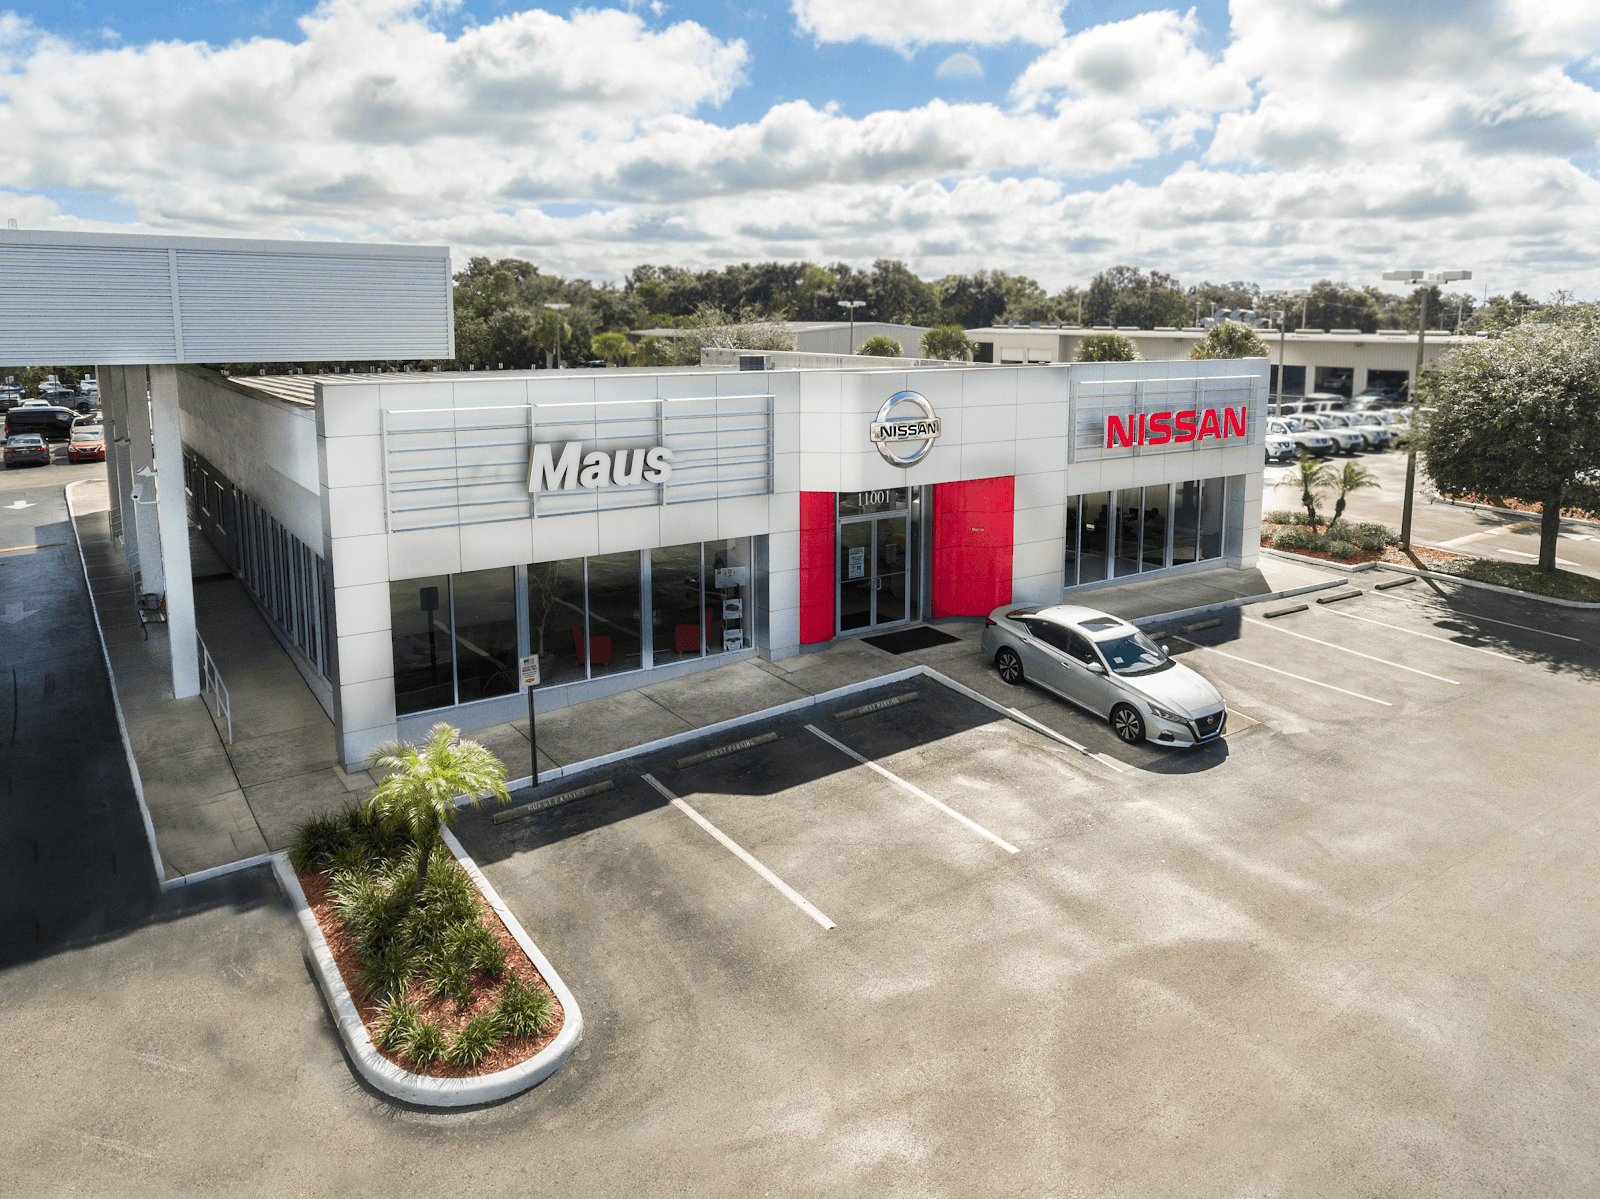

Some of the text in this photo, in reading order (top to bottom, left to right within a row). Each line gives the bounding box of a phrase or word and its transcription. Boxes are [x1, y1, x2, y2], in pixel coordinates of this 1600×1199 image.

[880, 422, 936, 438] NISSAN
[1105, 406, 1247, 449] NISSAN
[528, 441, 675, 493] Maus
[858, 490, 890, 507] 11001
[859, 697, 899, 713] GUEST PARKING
[706, 740, 755, 758] GUEST PARKING
[528, 789, 586, 811] GUEST PARKING
